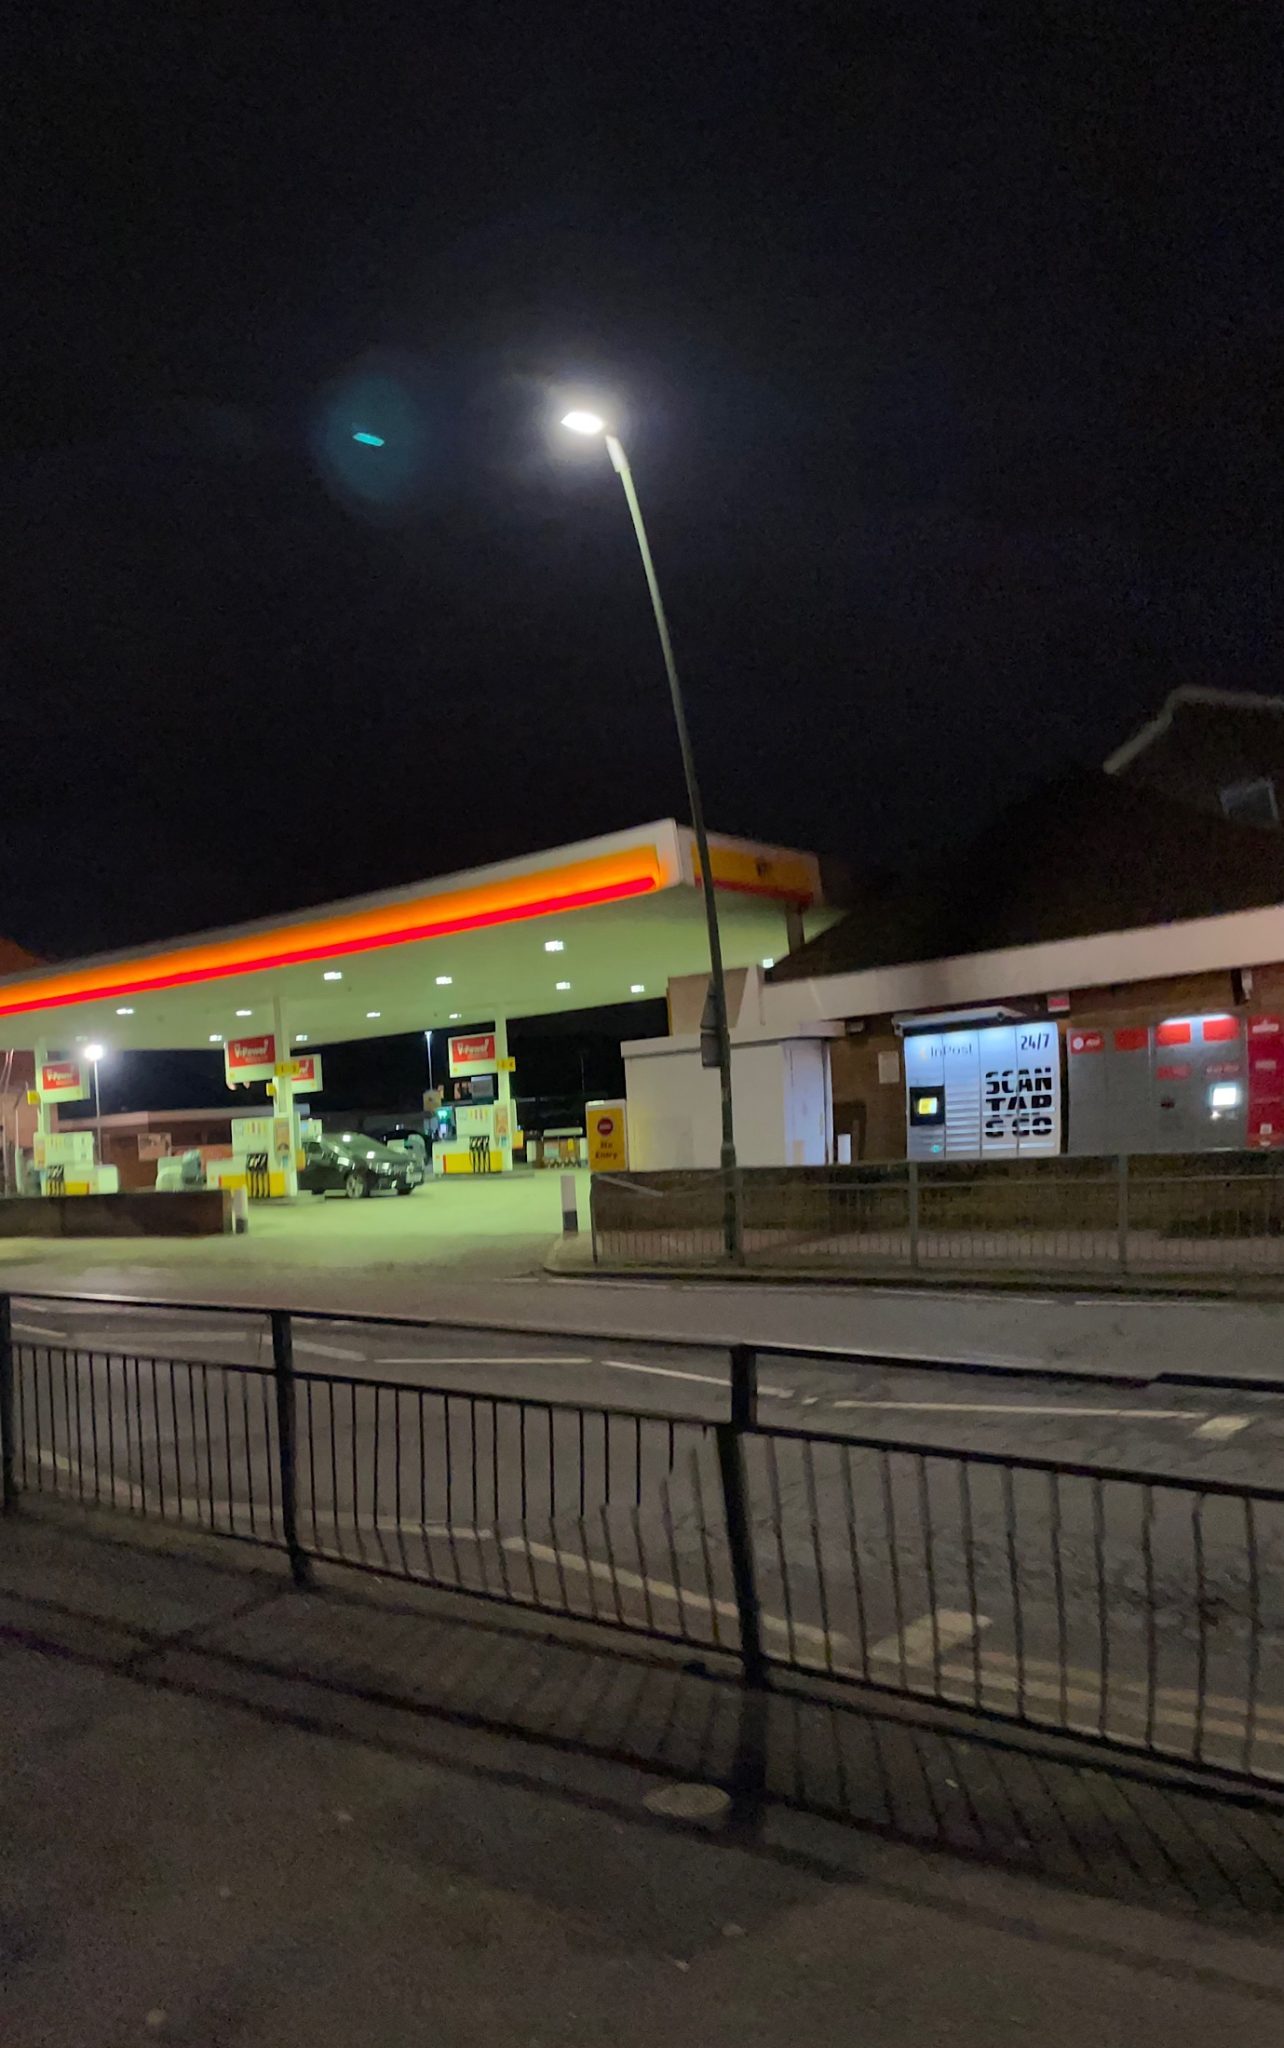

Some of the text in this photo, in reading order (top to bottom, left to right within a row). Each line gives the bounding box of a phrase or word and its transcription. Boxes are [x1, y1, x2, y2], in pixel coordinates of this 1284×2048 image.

[930, 1043, 974, 1058] InPost
[1020, 1033, 1051, 1051] 24/7
[985, 1067, 1053, 1096] SCAN
[985, 1094, 1053, 1117] TAP
[1012, 1117, 1053, 1137] GO
